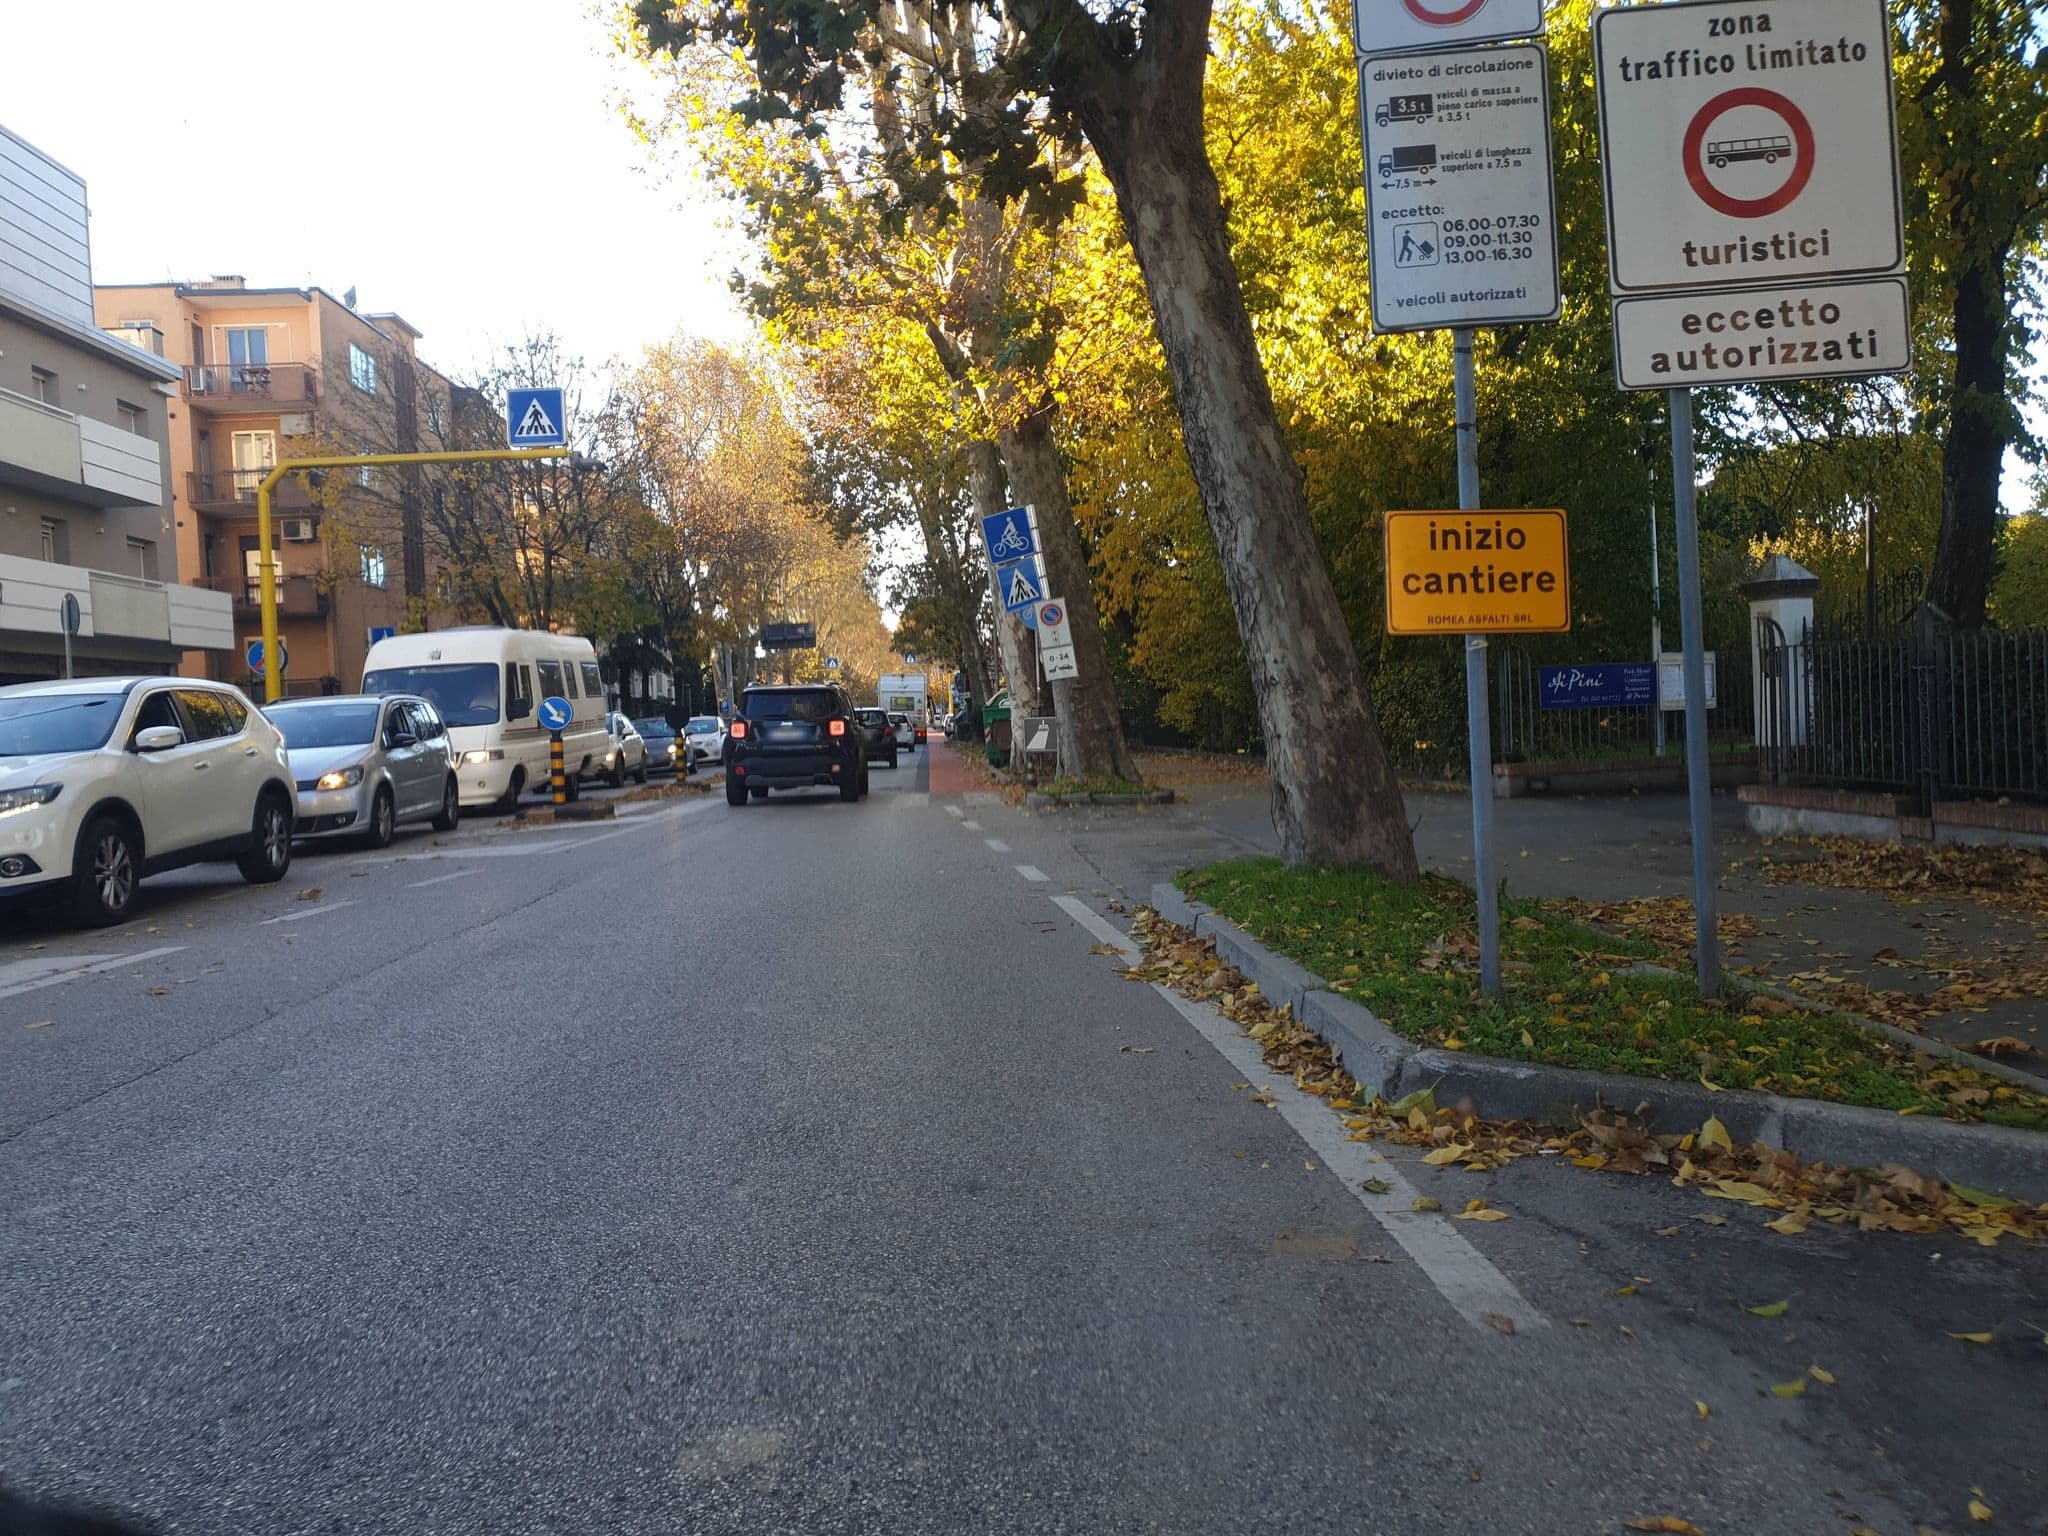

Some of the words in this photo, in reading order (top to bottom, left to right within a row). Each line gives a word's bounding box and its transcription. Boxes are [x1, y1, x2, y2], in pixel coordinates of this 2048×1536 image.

[1708, 13, 1772, 37] zona
[1619, 49, 1735, 82] traffico
[1746, 36, 1867, 71] limitato
[1373, 67, 1423, 82] divieto
[1428, 65, 1441, 78] di
[1445, 58, 1534, 77] circolazione
[1436, 87, 1467, 100] veicoli
[1471, 86, 1479, 97] di
[1482, 86, 1511, 96] massa
[1514, 86, 1521, 94] a
[1420, 101, 1426, 112] t
[1437, 101, 1461, 113] pieno
[1464, 98, 1493, 109] carico
[1496, 95, 1539, 107] superiore
[1438, 114, 1444, 123] a
[1465, 112, 1471, 121] t
[1440, 149, 1472, 161] veicoli
[1475, 148, 1483, 158] di
[1487, 146, 1532, 159] lunghezza
[1441, 161, 1483, 174] superiore
[1487, 161, 1493, 169] a
[1513, 160, 1521, 168] m
[1381, 205, 1445, 220] eccetto:
[1443, 214, 1540, 233] 06.00-07.30
[1444, 231, 1533, 249] 09.00-11.30
[1682, 228, 1830, 268] turistici
[1444, 246, 1533, 264] 13.00-16.30
[1396, 291, 1446, 308] veicoli
[1450, 286, 1527, 303] autorizzati
[1681, 298, 1841, 335] eccetto
[1650, 328, 1878, 374] autorizzati
[1429, 520, 1527, 551] inizio
[1402, 564, 1556, 595] cantiere
[1427, 614, 1465, 625] ROMEA
[1468, 613, 1510, 625] ASPALTI
[1513, 613, 1534, 624] SRL
